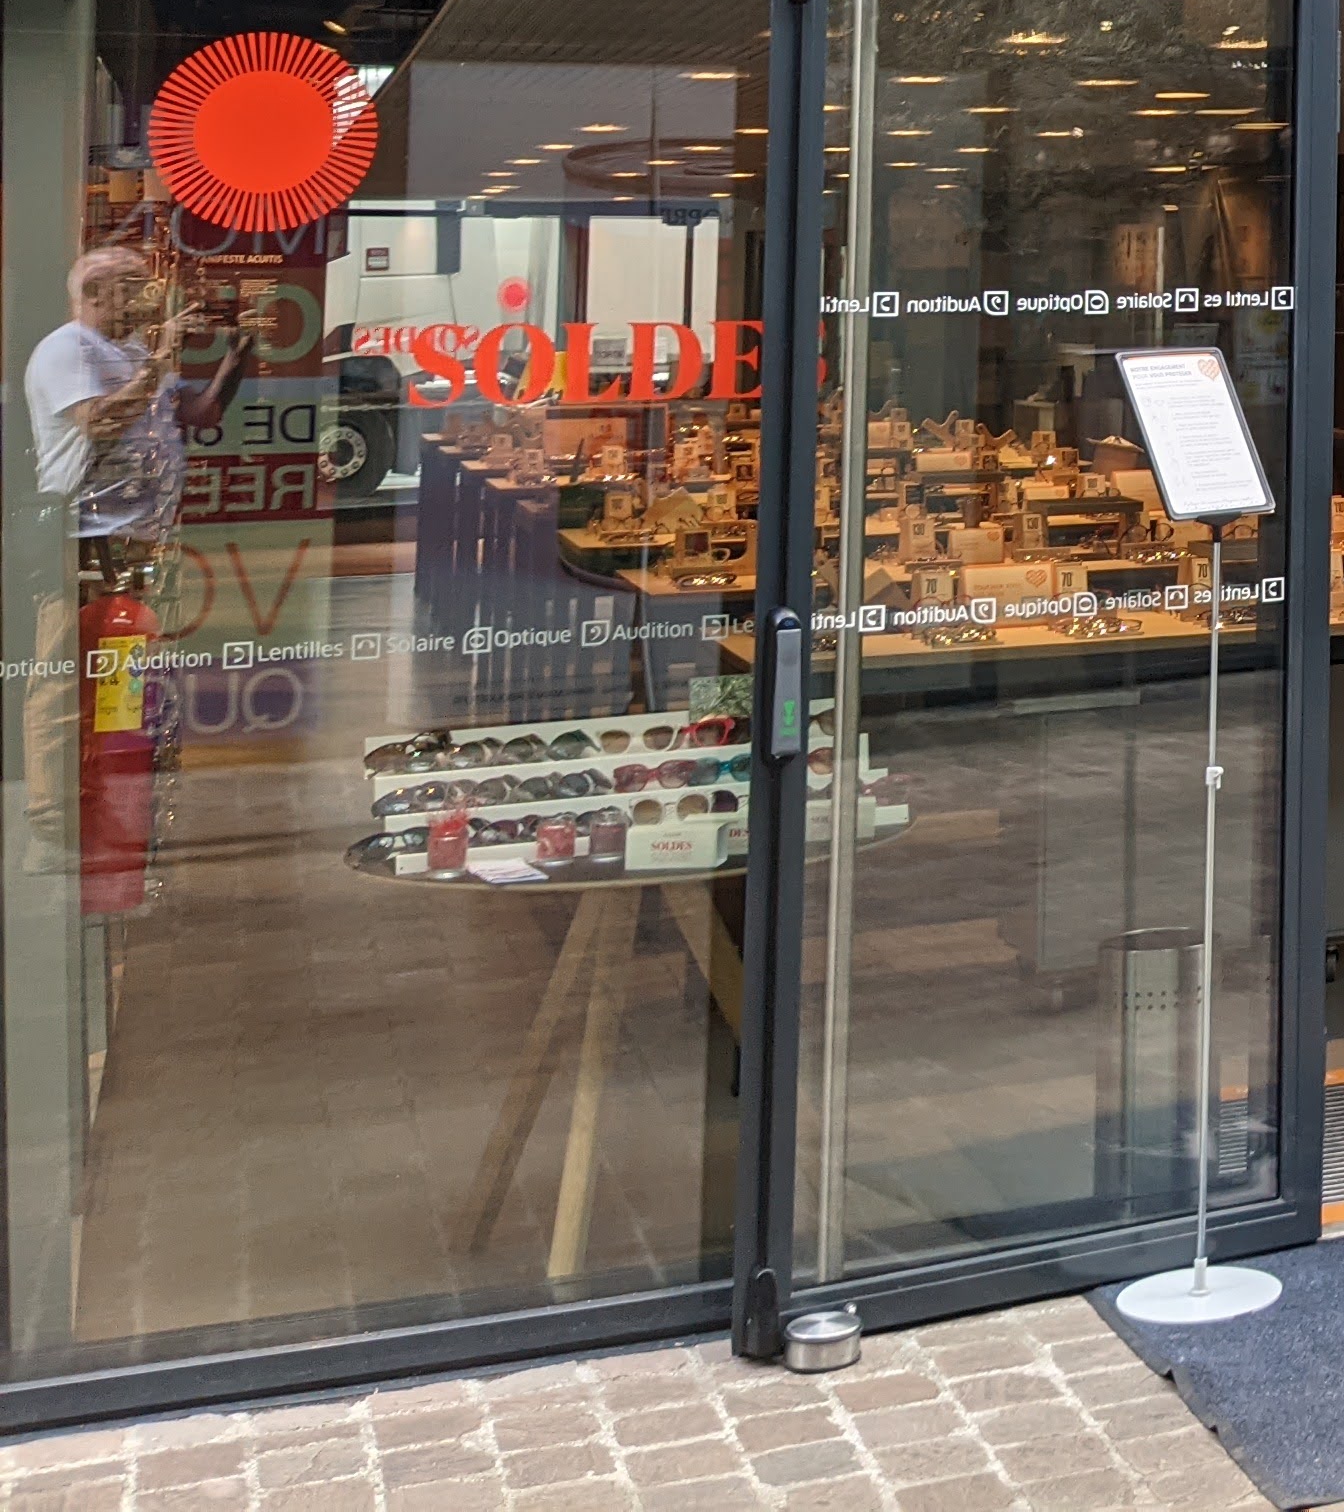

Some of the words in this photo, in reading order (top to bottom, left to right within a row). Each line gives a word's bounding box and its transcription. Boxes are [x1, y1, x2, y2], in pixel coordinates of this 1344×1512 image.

[408, 318, 827, 410] SOLDE
[120, 648, 213, 672] Audition
[257, 639, 344, 663] Lentilles
[386, 633, 456, 655] Solaire
[494, 626, 572, 649] Optique
[612, 620, 694, 641] Audition
[651, 840, 693, 852] SOLDES
